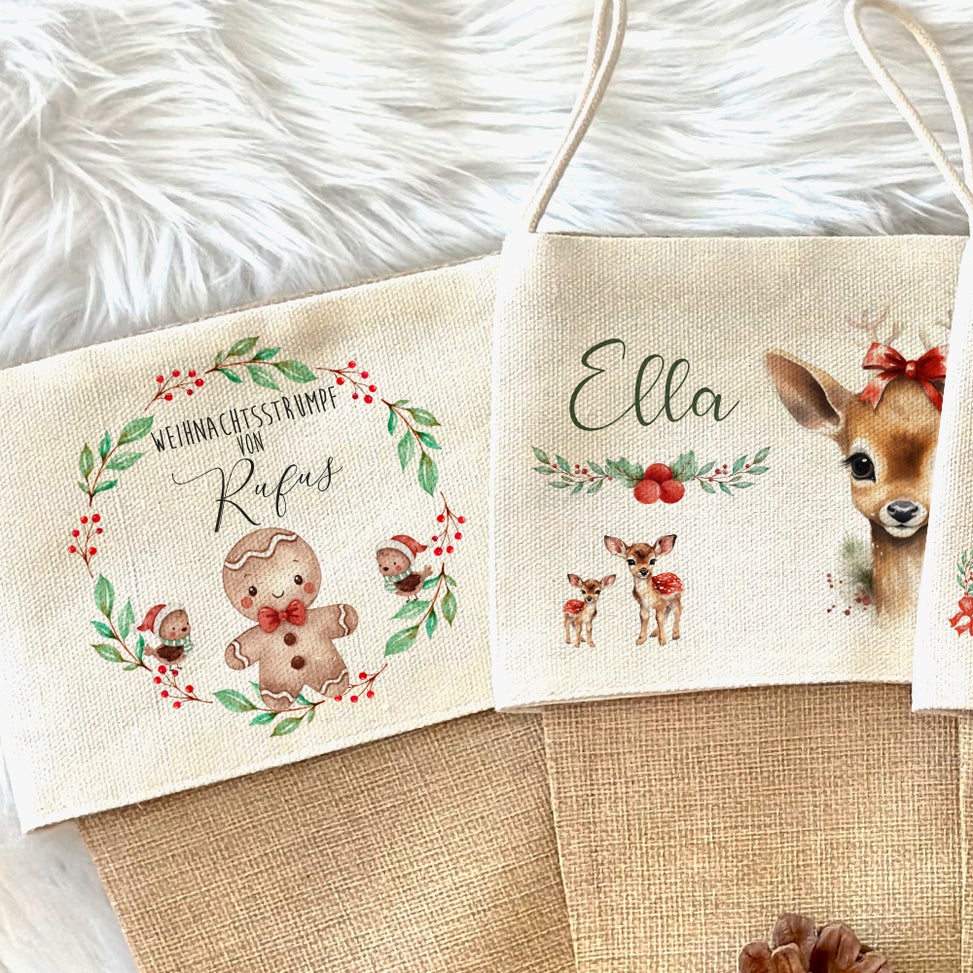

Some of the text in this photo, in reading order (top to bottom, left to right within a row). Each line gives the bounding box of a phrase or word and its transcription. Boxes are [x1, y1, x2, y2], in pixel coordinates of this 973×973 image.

[151, 386, 338, 452] WEIHNACHTSSTRUMPF
[569, 338, 740, 431] Ella
[237, 431, 264, 456] VON
[172, 457, 342, 532] Rufus
